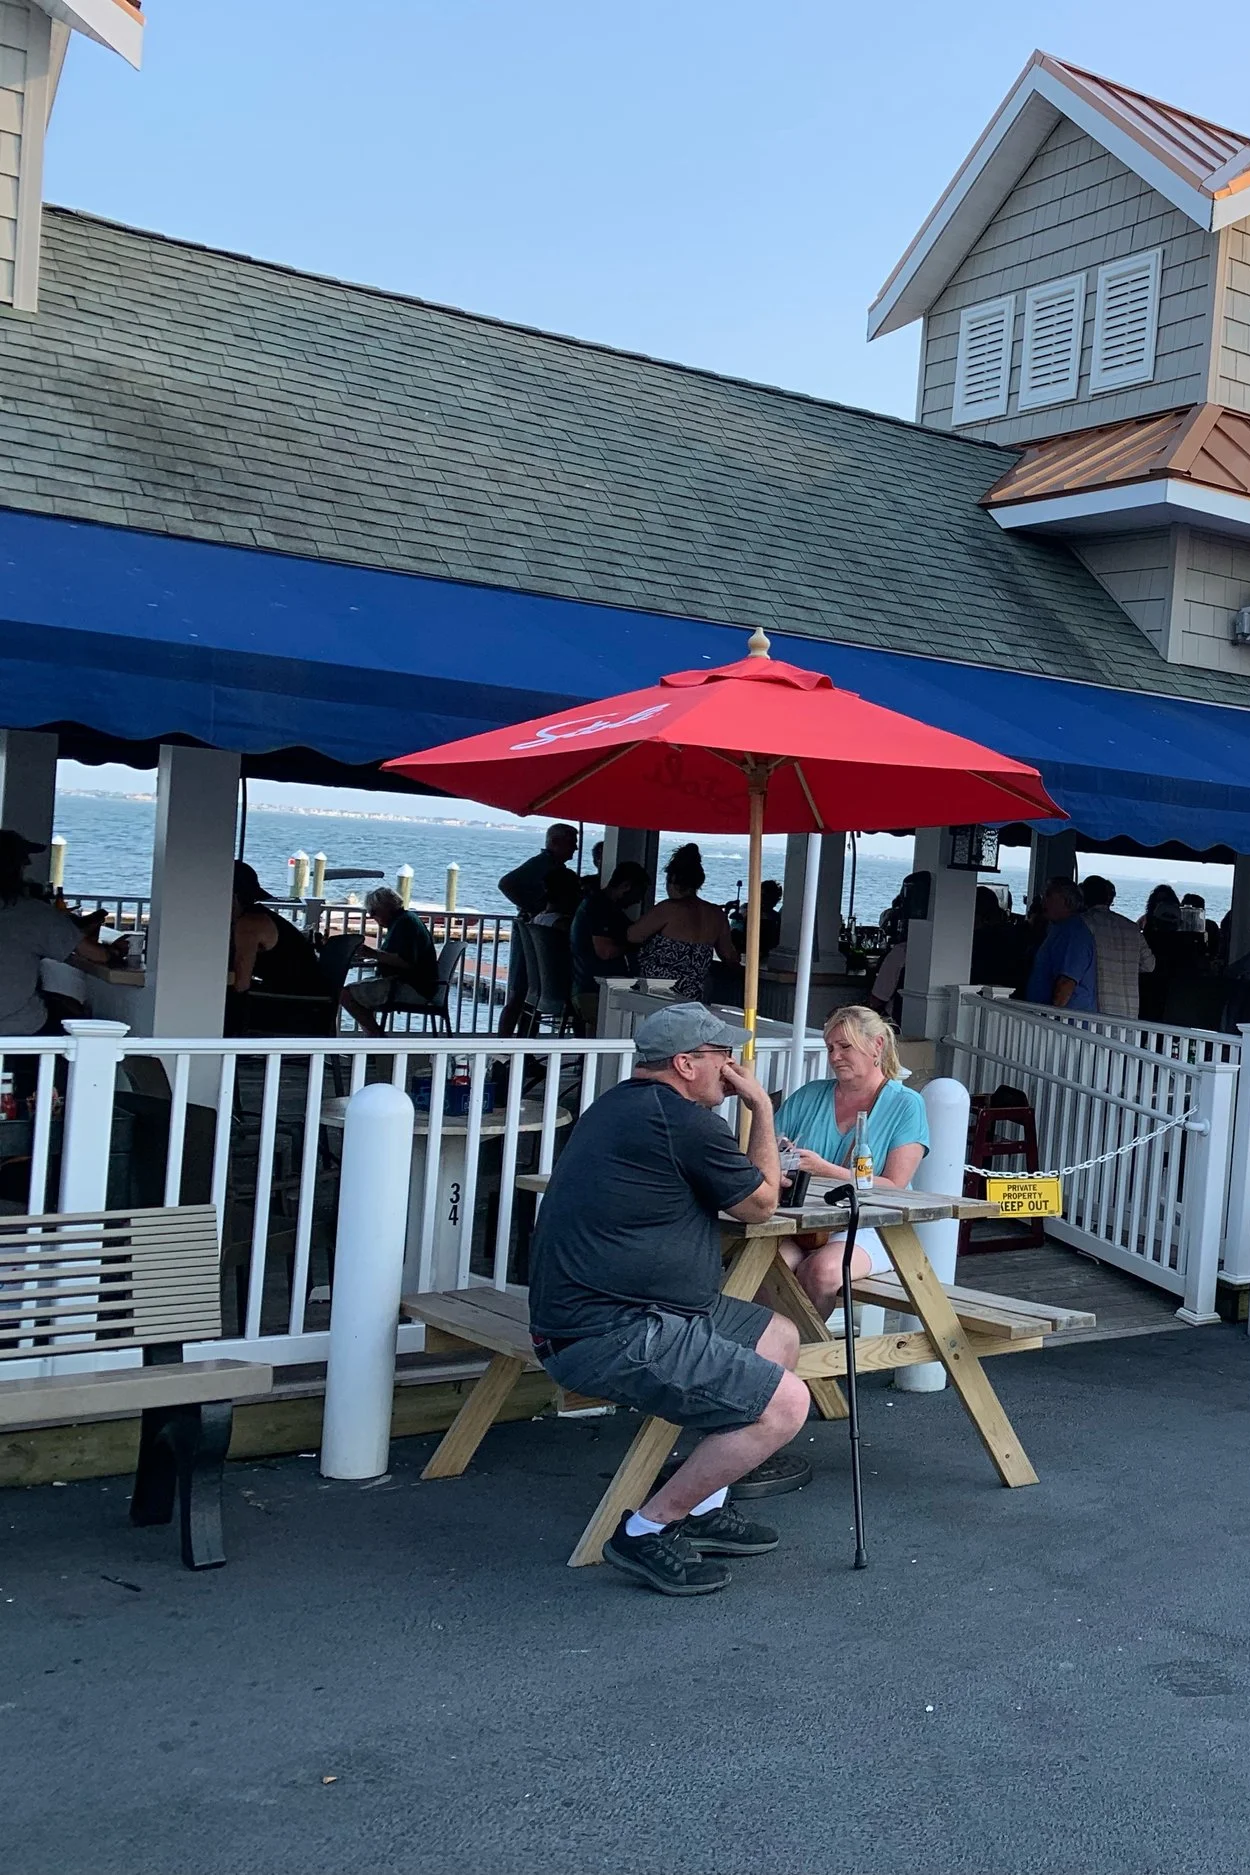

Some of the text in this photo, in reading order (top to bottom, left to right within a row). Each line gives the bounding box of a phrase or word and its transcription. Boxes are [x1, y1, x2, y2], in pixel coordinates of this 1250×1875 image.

[1007, 1184, 1038, 1192] PRIVATE
[1002, 1192, 1043, 1200] PROPERTY
[1028, 1200, 1050, 1211] OUT
